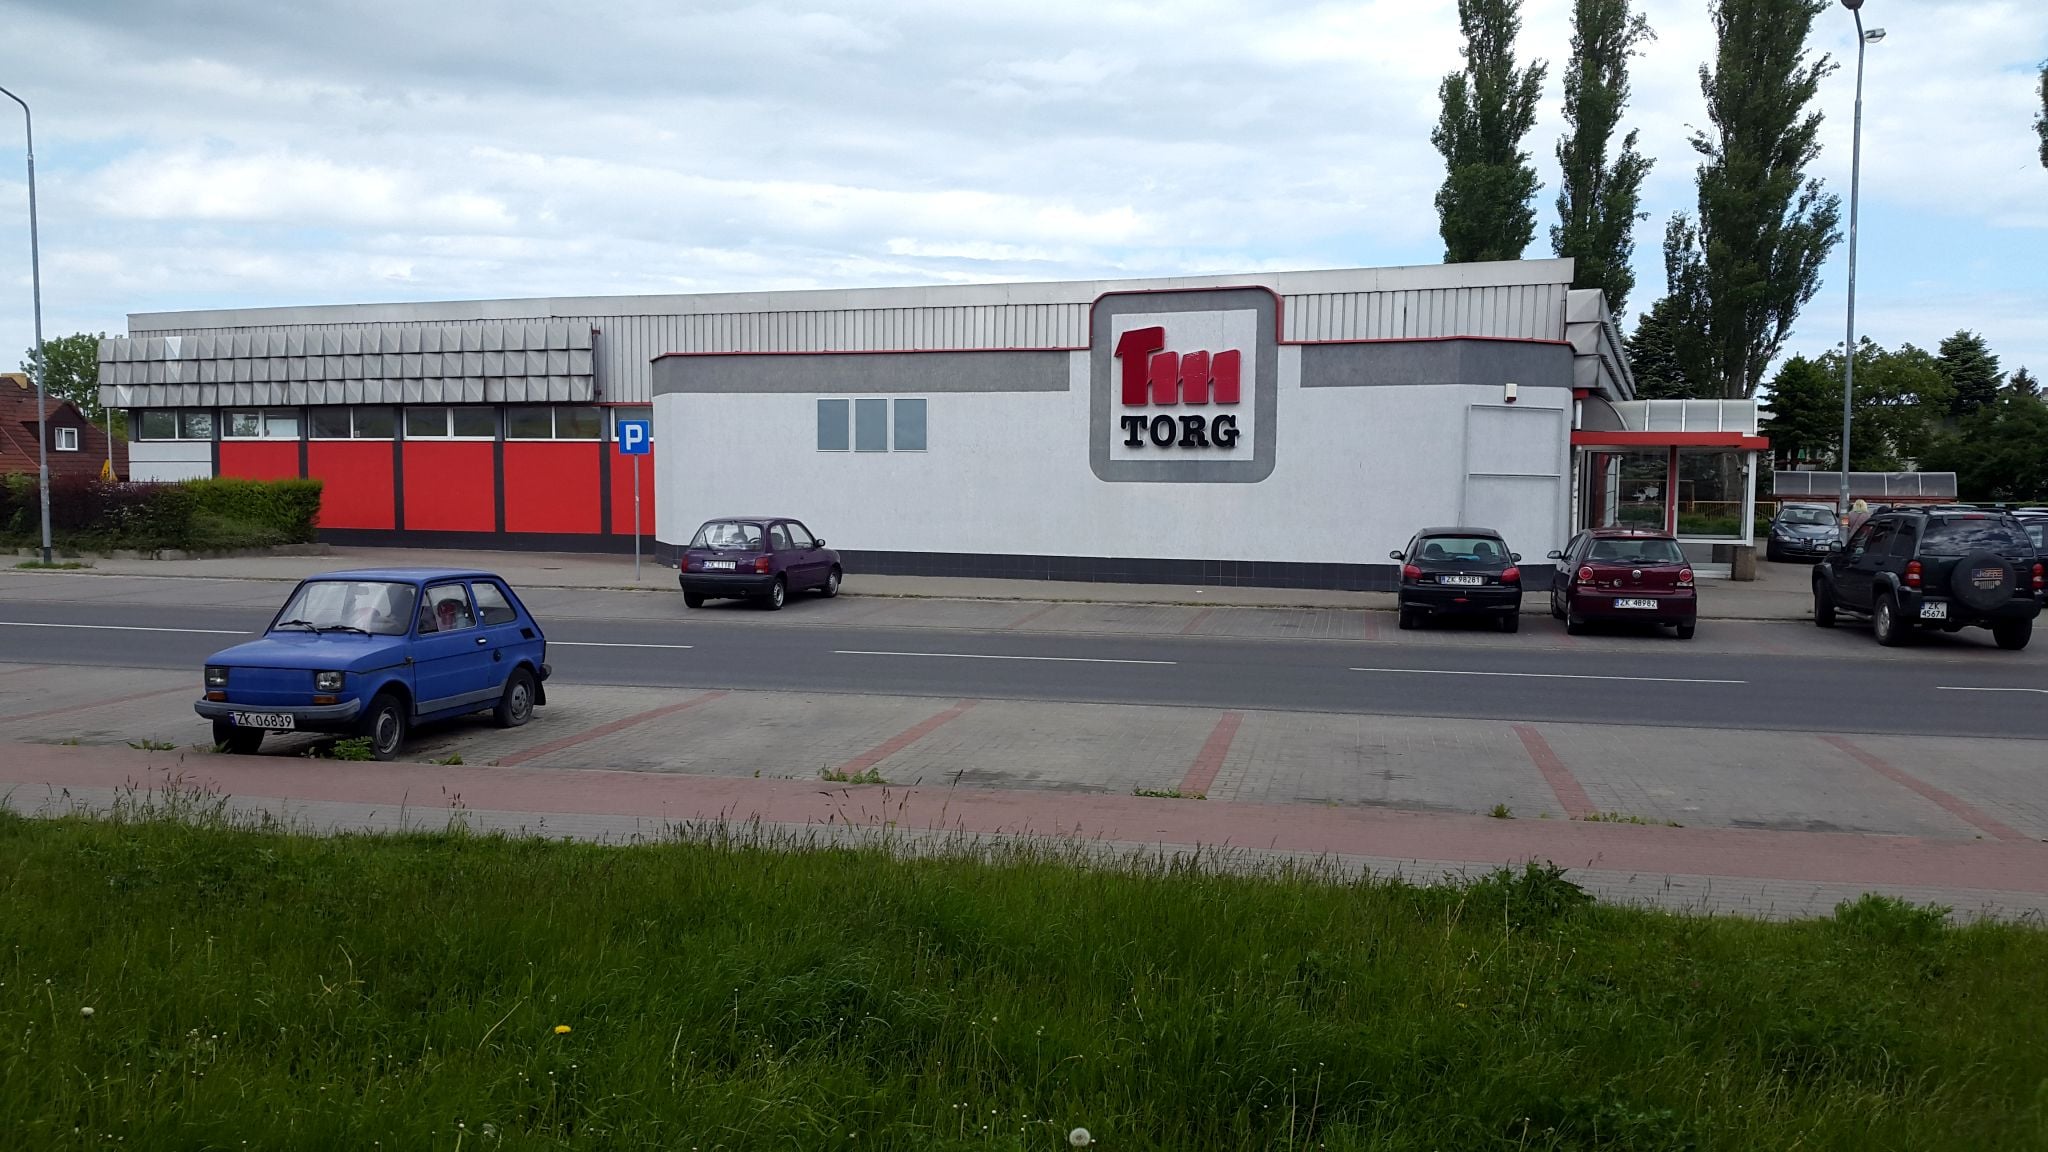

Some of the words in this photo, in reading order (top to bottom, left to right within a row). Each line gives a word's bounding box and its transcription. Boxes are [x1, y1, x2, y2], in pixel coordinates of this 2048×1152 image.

[625, 424, 643, 451] P
[1120, 414, 1240, 448] TORG
[1928, 602, 1940, 610] ZK
[1921, 610, 1945, 618] 4567A
[236, 714, 252, 725] ZK
[255, 715, 291, 727] 06839
